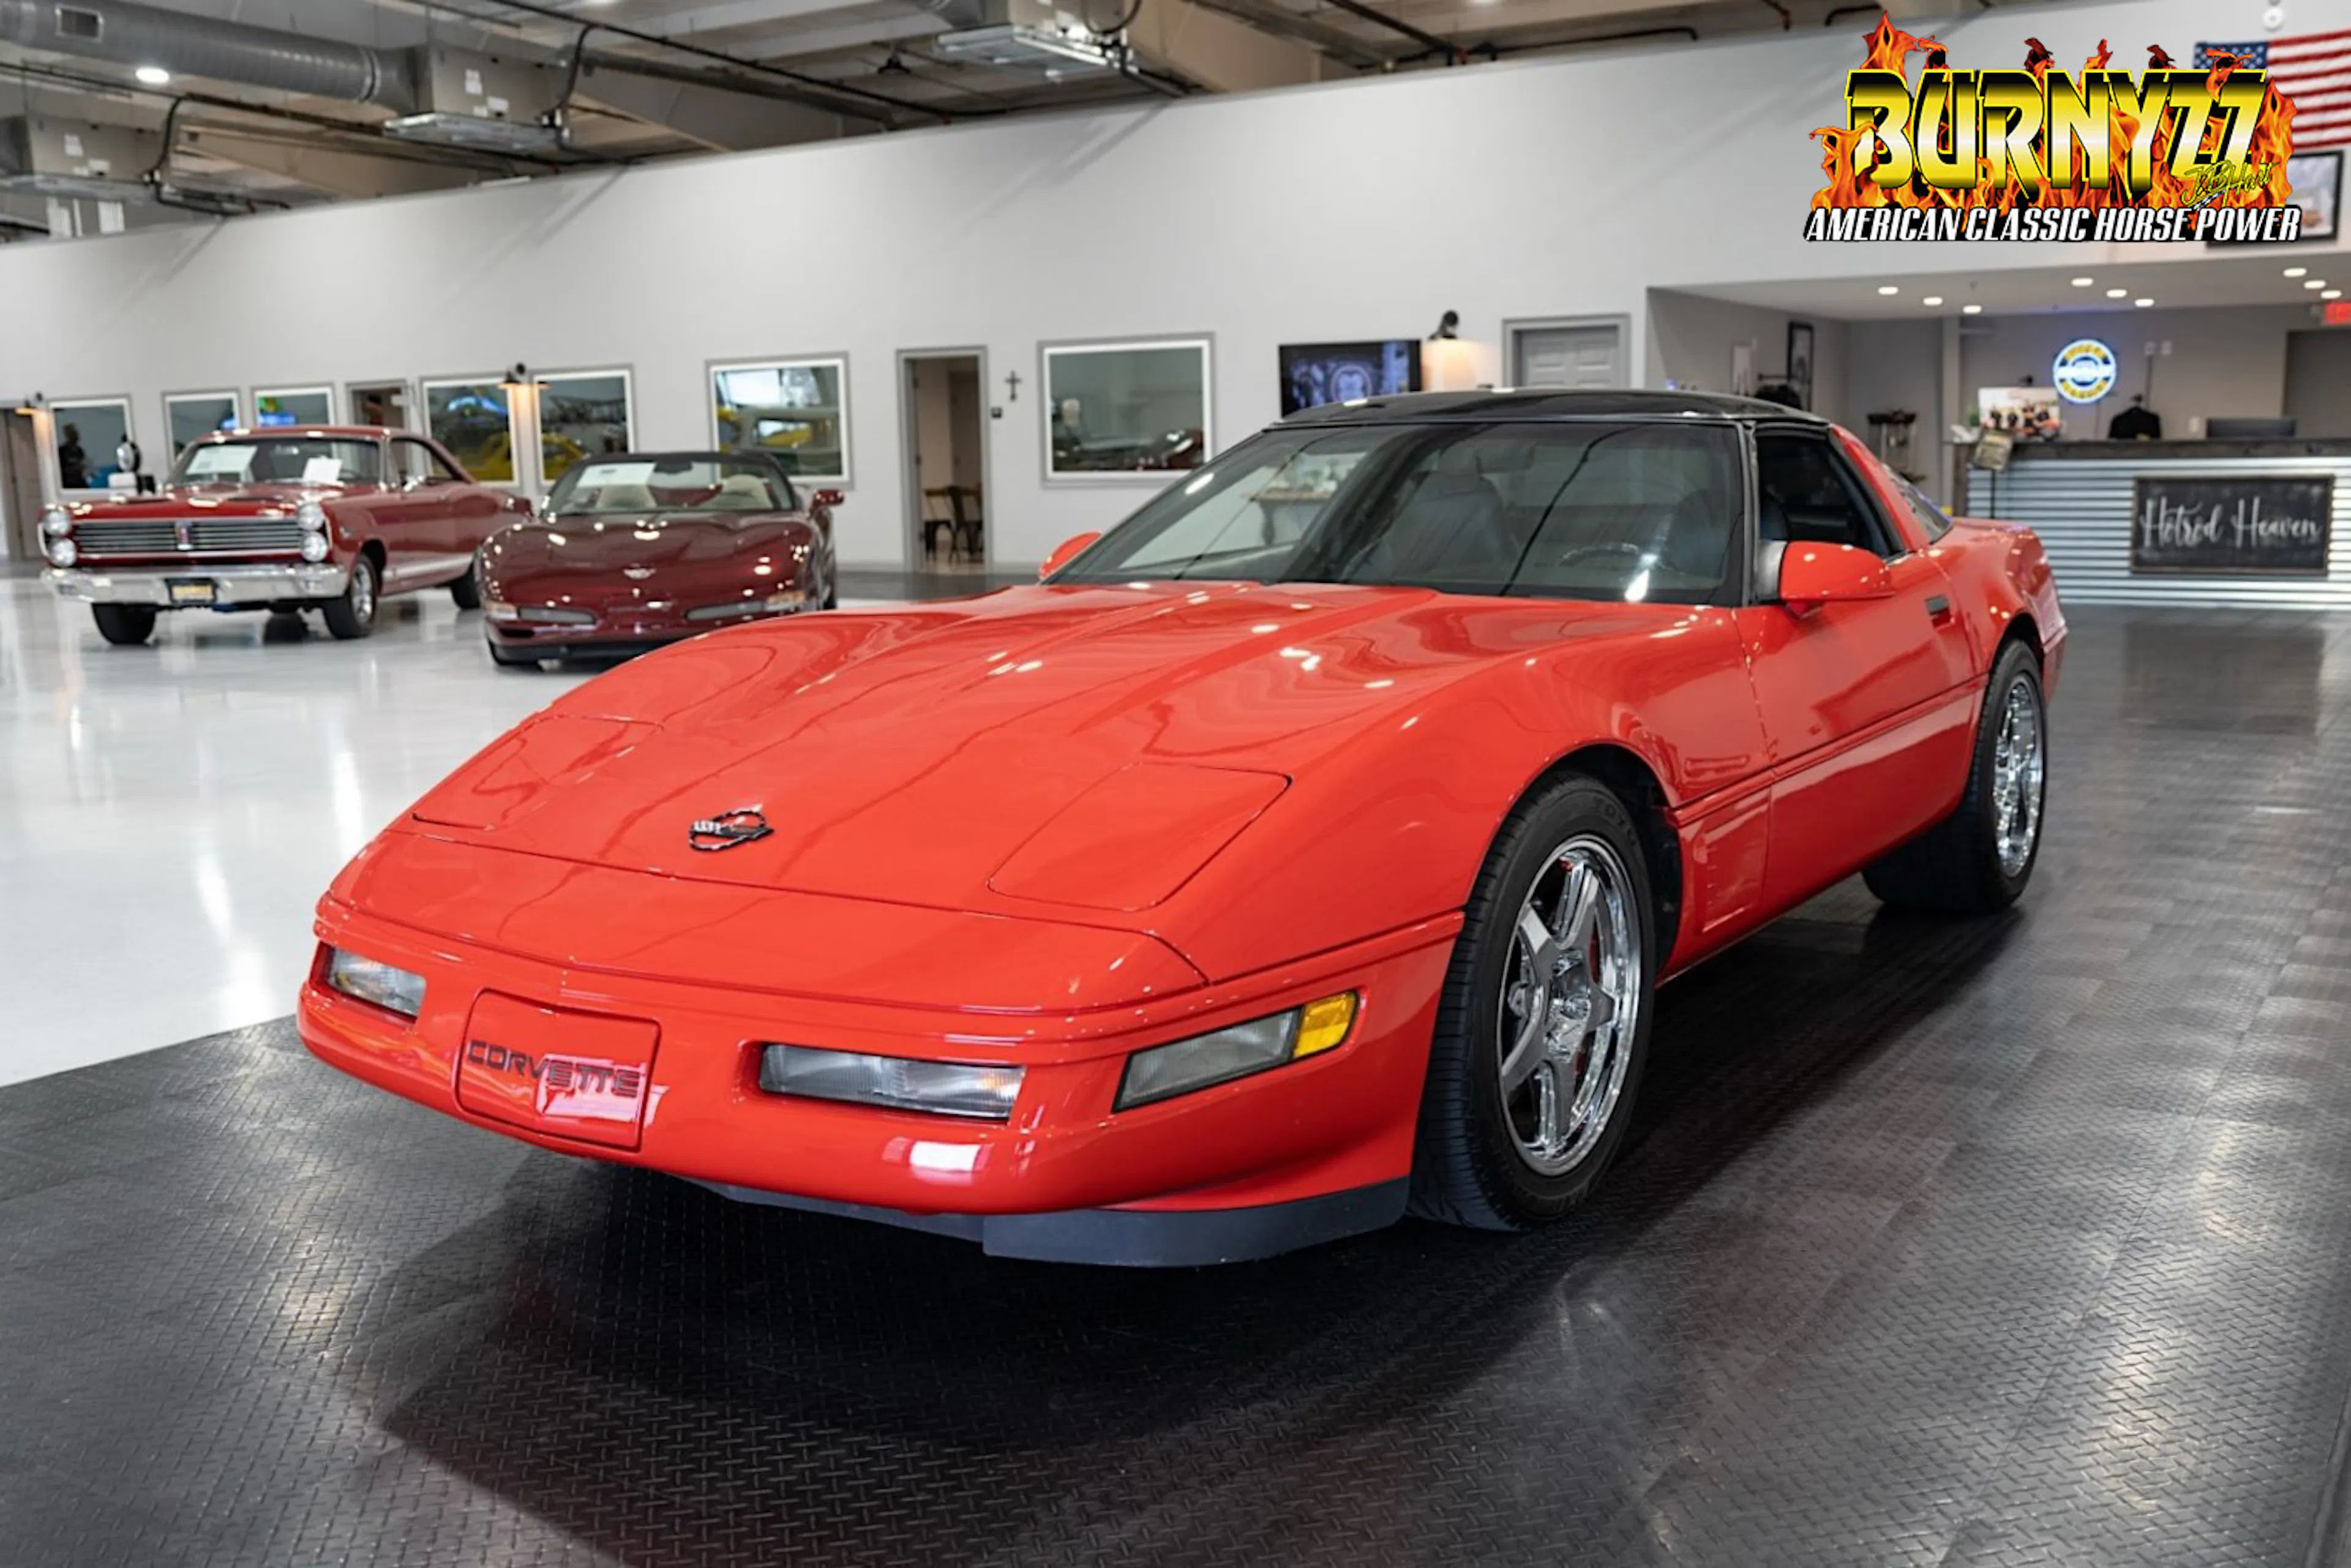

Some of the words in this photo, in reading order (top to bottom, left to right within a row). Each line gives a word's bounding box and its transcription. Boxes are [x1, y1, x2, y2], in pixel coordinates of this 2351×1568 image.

[2140, 496, 2224, 549] Hotrod
[2232, 497, 2322, 549] Heaven
[467, 1040, 641, 1098] CORVETTE
